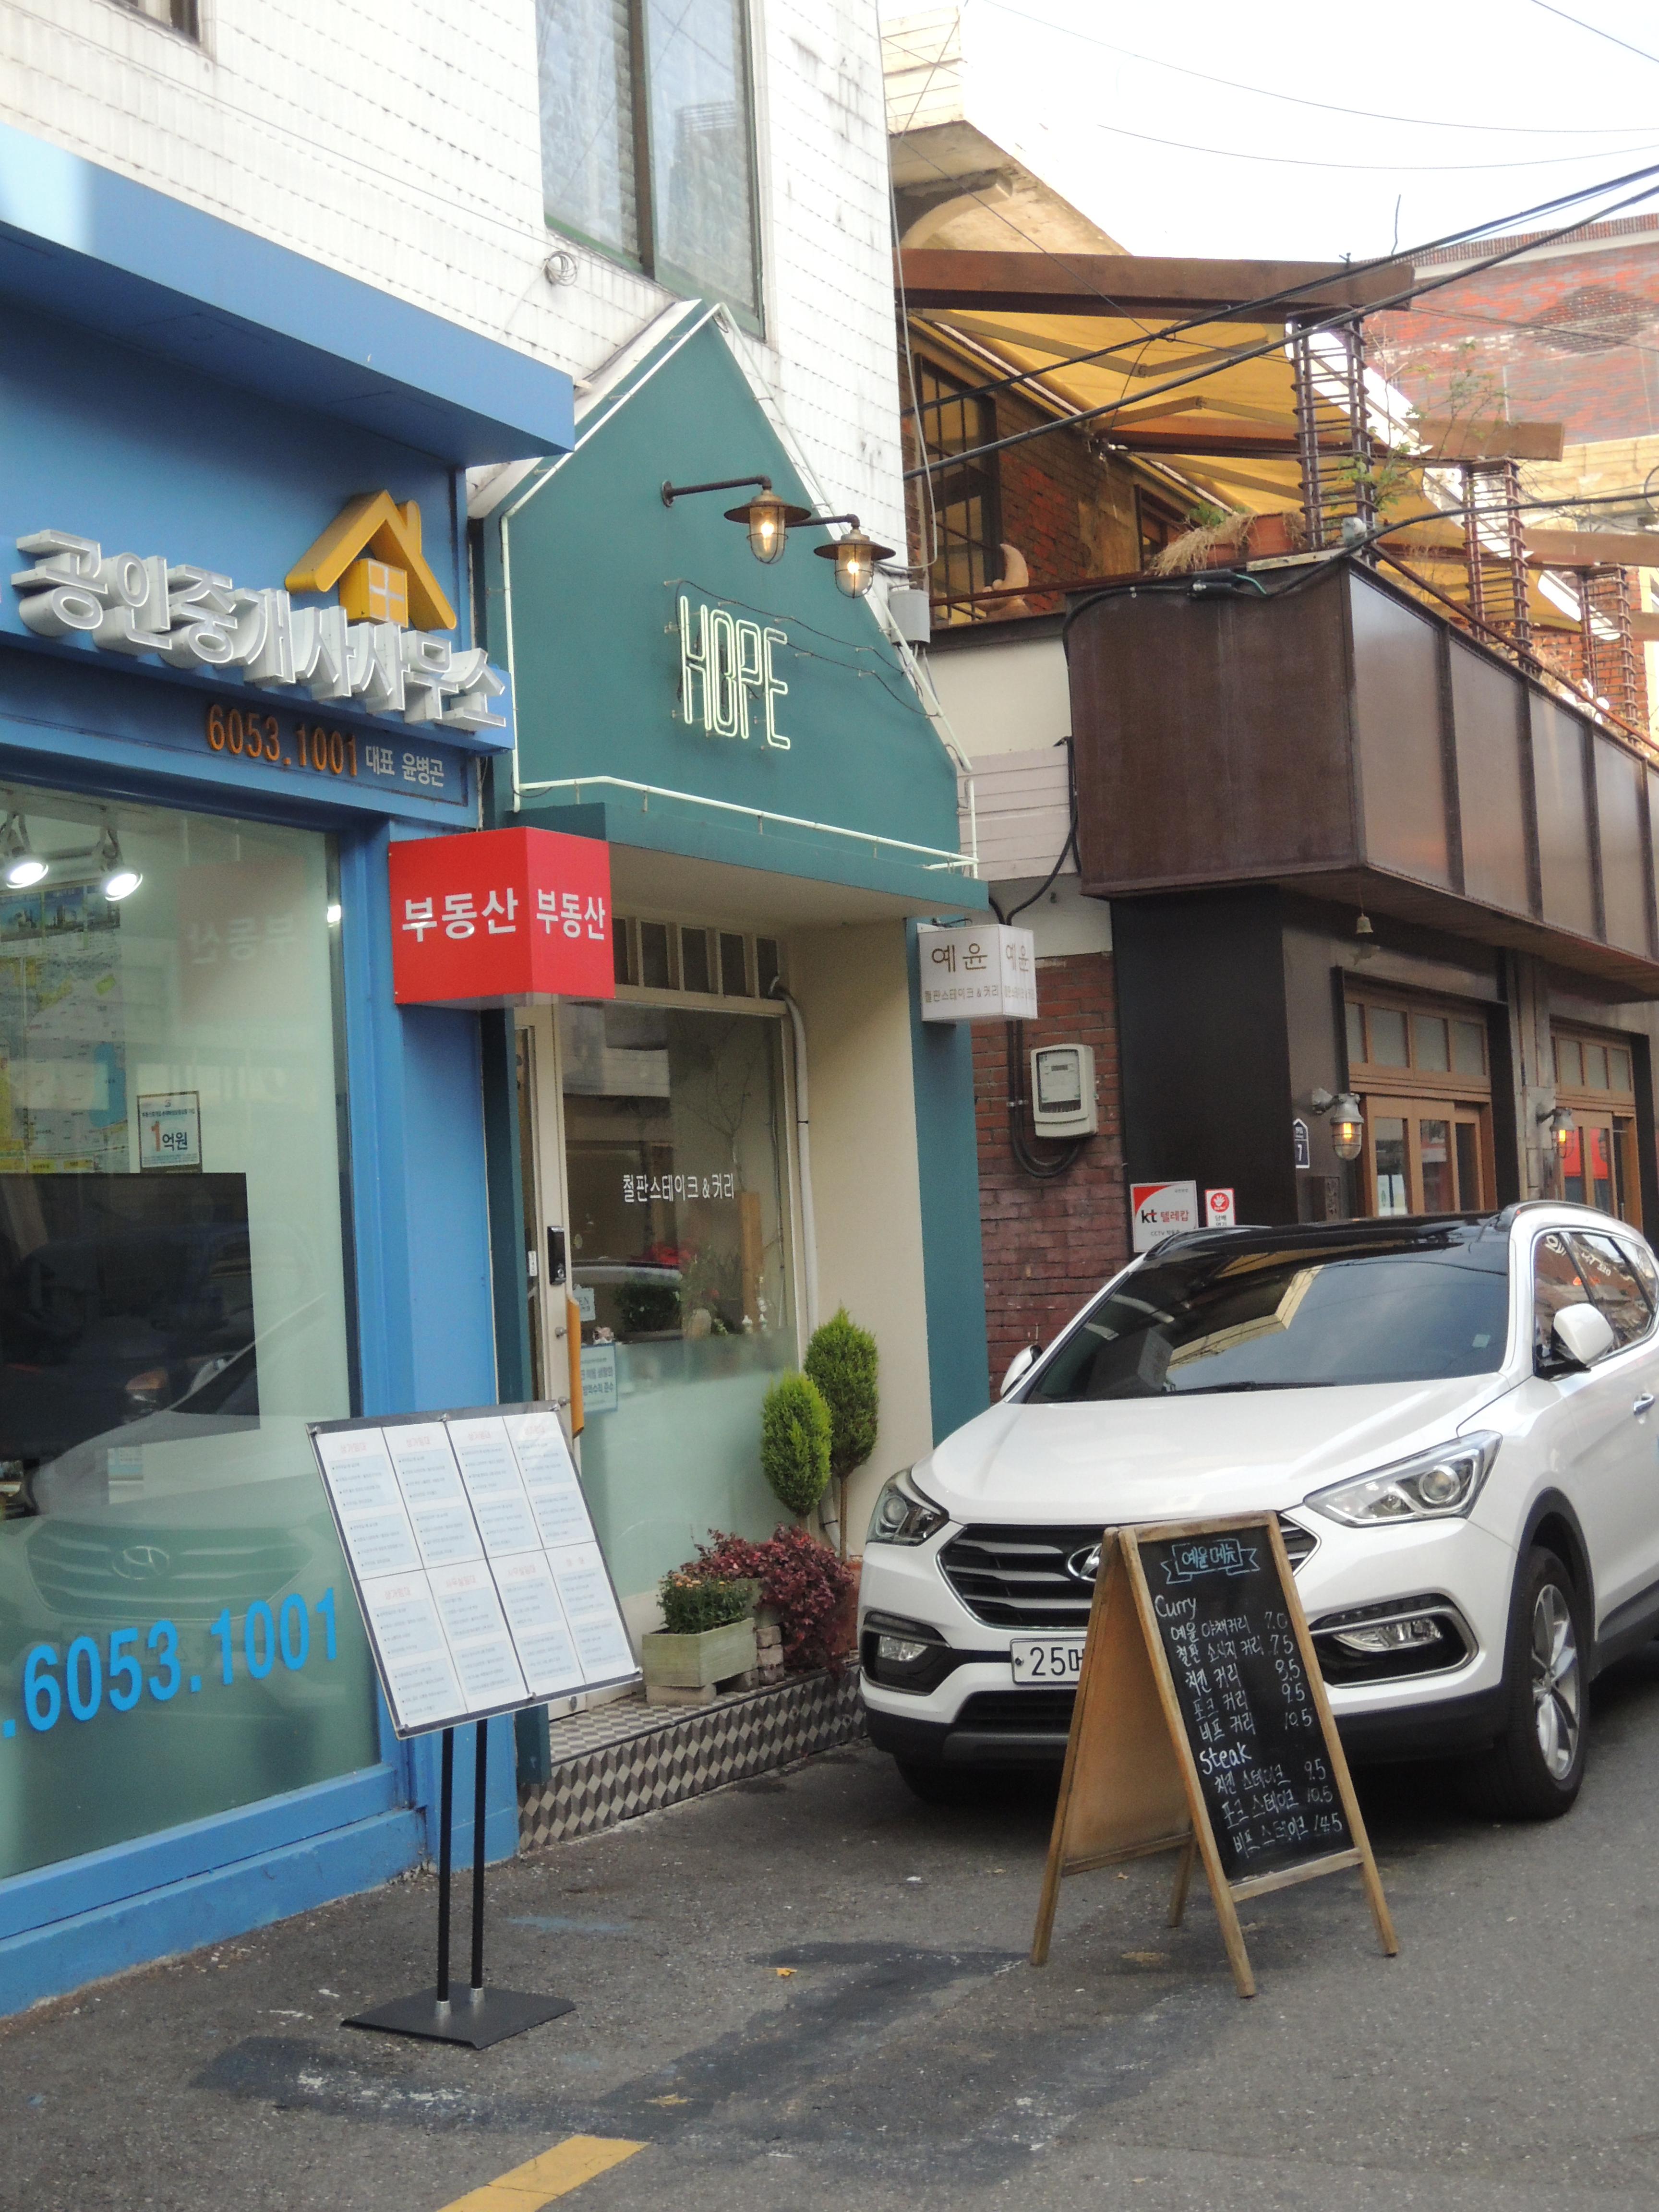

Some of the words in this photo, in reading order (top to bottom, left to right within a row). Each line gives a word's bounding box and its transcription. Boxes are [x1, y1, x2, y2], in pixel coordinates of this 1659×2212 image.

[12, 529, 506, 730] 공인중개사사무소
[679, 595, 791, 750] HOPE
[206, 704, 358, 777] 6053.1001
[366, 745, 395, 776] 대표
[402, 888, 518, 942] 부동산
[536, 889, 605, 940] 부동산
[623, 1174, 698, 1202] 철판스테이크
[702, 1178, 710, 1199] &
[712, 1173, 734, 1199] 커리
[1141, 1209, 1157, 1224] kt
[1160, 1210, 1189, 1223] 텔레캅
[1209, 1543, 1238, 1565] 메뉴
[1154, 1595, 1196, 1620] Curry
[1264, 1611, 1288, 1630] 7.0
[1176, 1644, 1201, 1668] 철판
[1240, 1635, 1264, 1655] 커리
[1185, 1668, 1212, 1696] 치킨
[1214, 1662, 1242, 1689] 커리
[1193, 1698, 1219, 1722] 포크
[1222, 1689, 1249, 1711] 커리
[1199, 1718, 1226, 1743] 비프
[1230, 1711, 1256, 1735] 커리
[1285, 1708, 1312, 1730] 10.5
[1200, 1742, 1252, 1775] Steak
[1214, 1770, 1237, 1795] 치킨
[1242, 1764, 1292, 1791] 스테이크
[1304, 1758, 1326, 1780] 9.5
[1221, 1798, 1250, 1829] 포크
[1252, 1788, 1299, 1819] 스테이크
[1307, 1785, 1334, 1803] 10.5
[1232, 1829, 1261, 1859] 비프
[1261, 1815, 1309, 1846] 스테이크
